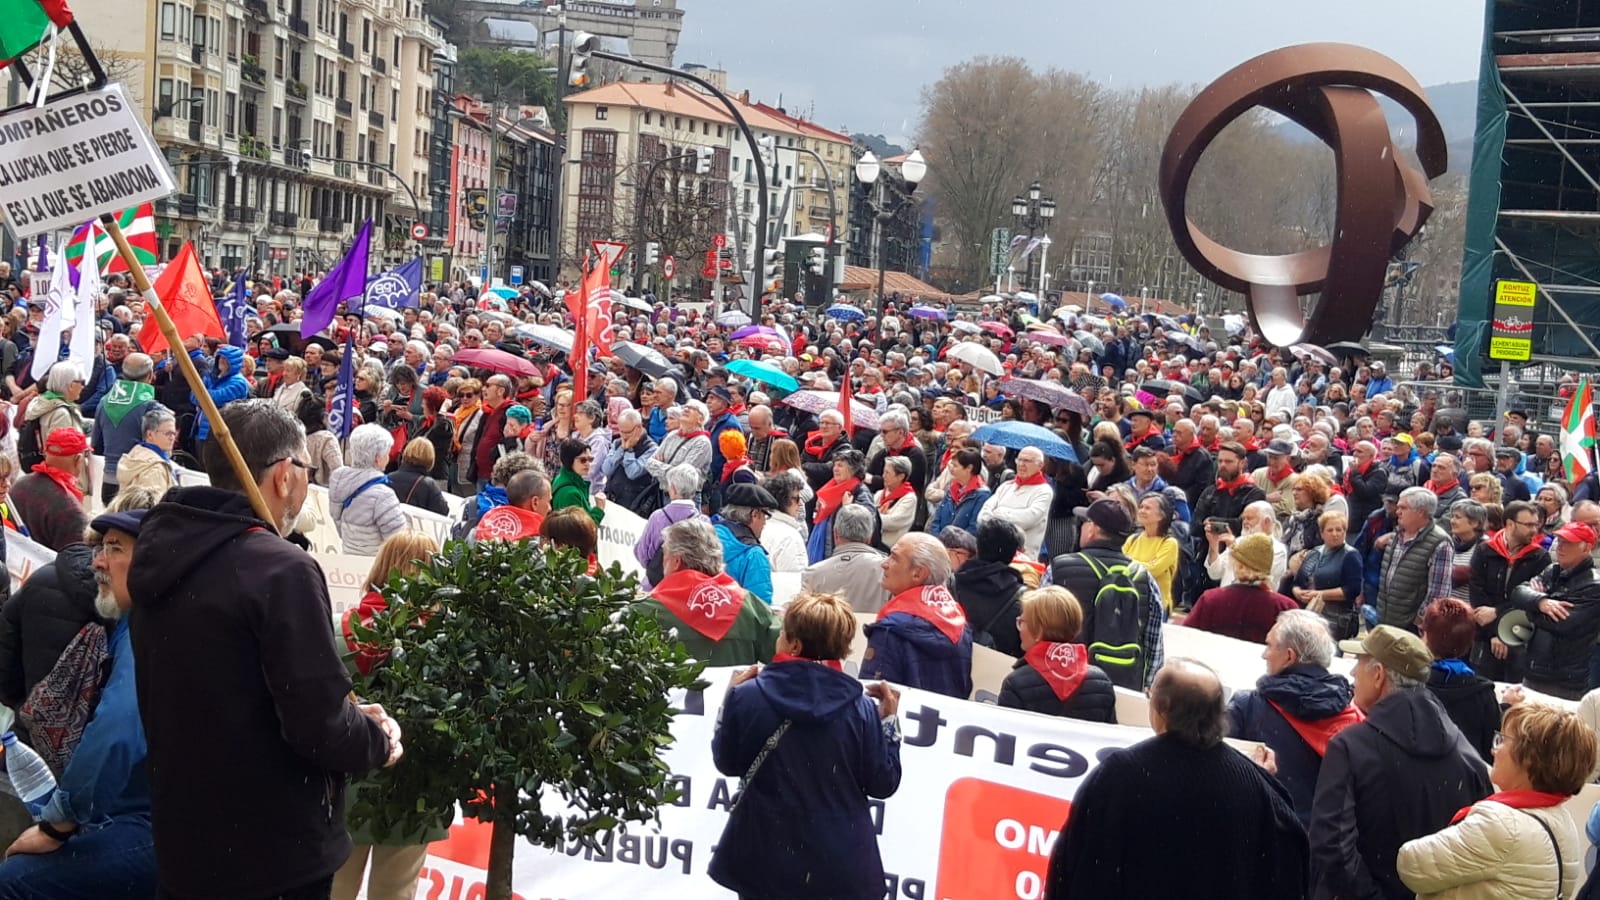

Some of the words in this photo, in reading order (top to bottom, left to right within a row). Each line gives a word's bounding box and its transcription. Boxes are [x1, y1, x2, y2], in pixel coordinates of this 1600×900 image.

[8, 153, 52, 183] LUCHA
[47, 145, 77, 173] QUE
[73, 140, 95, 165] SE
[89, 128, 138, 160] PIERDE
[6, 200, 29, 227] ES
[25, 197, 48, 224] LA
[42, 188, 74, 218] QUE
[69, 183, 92, 210] SE
[87, 163, 162, 206] ABANDONA
